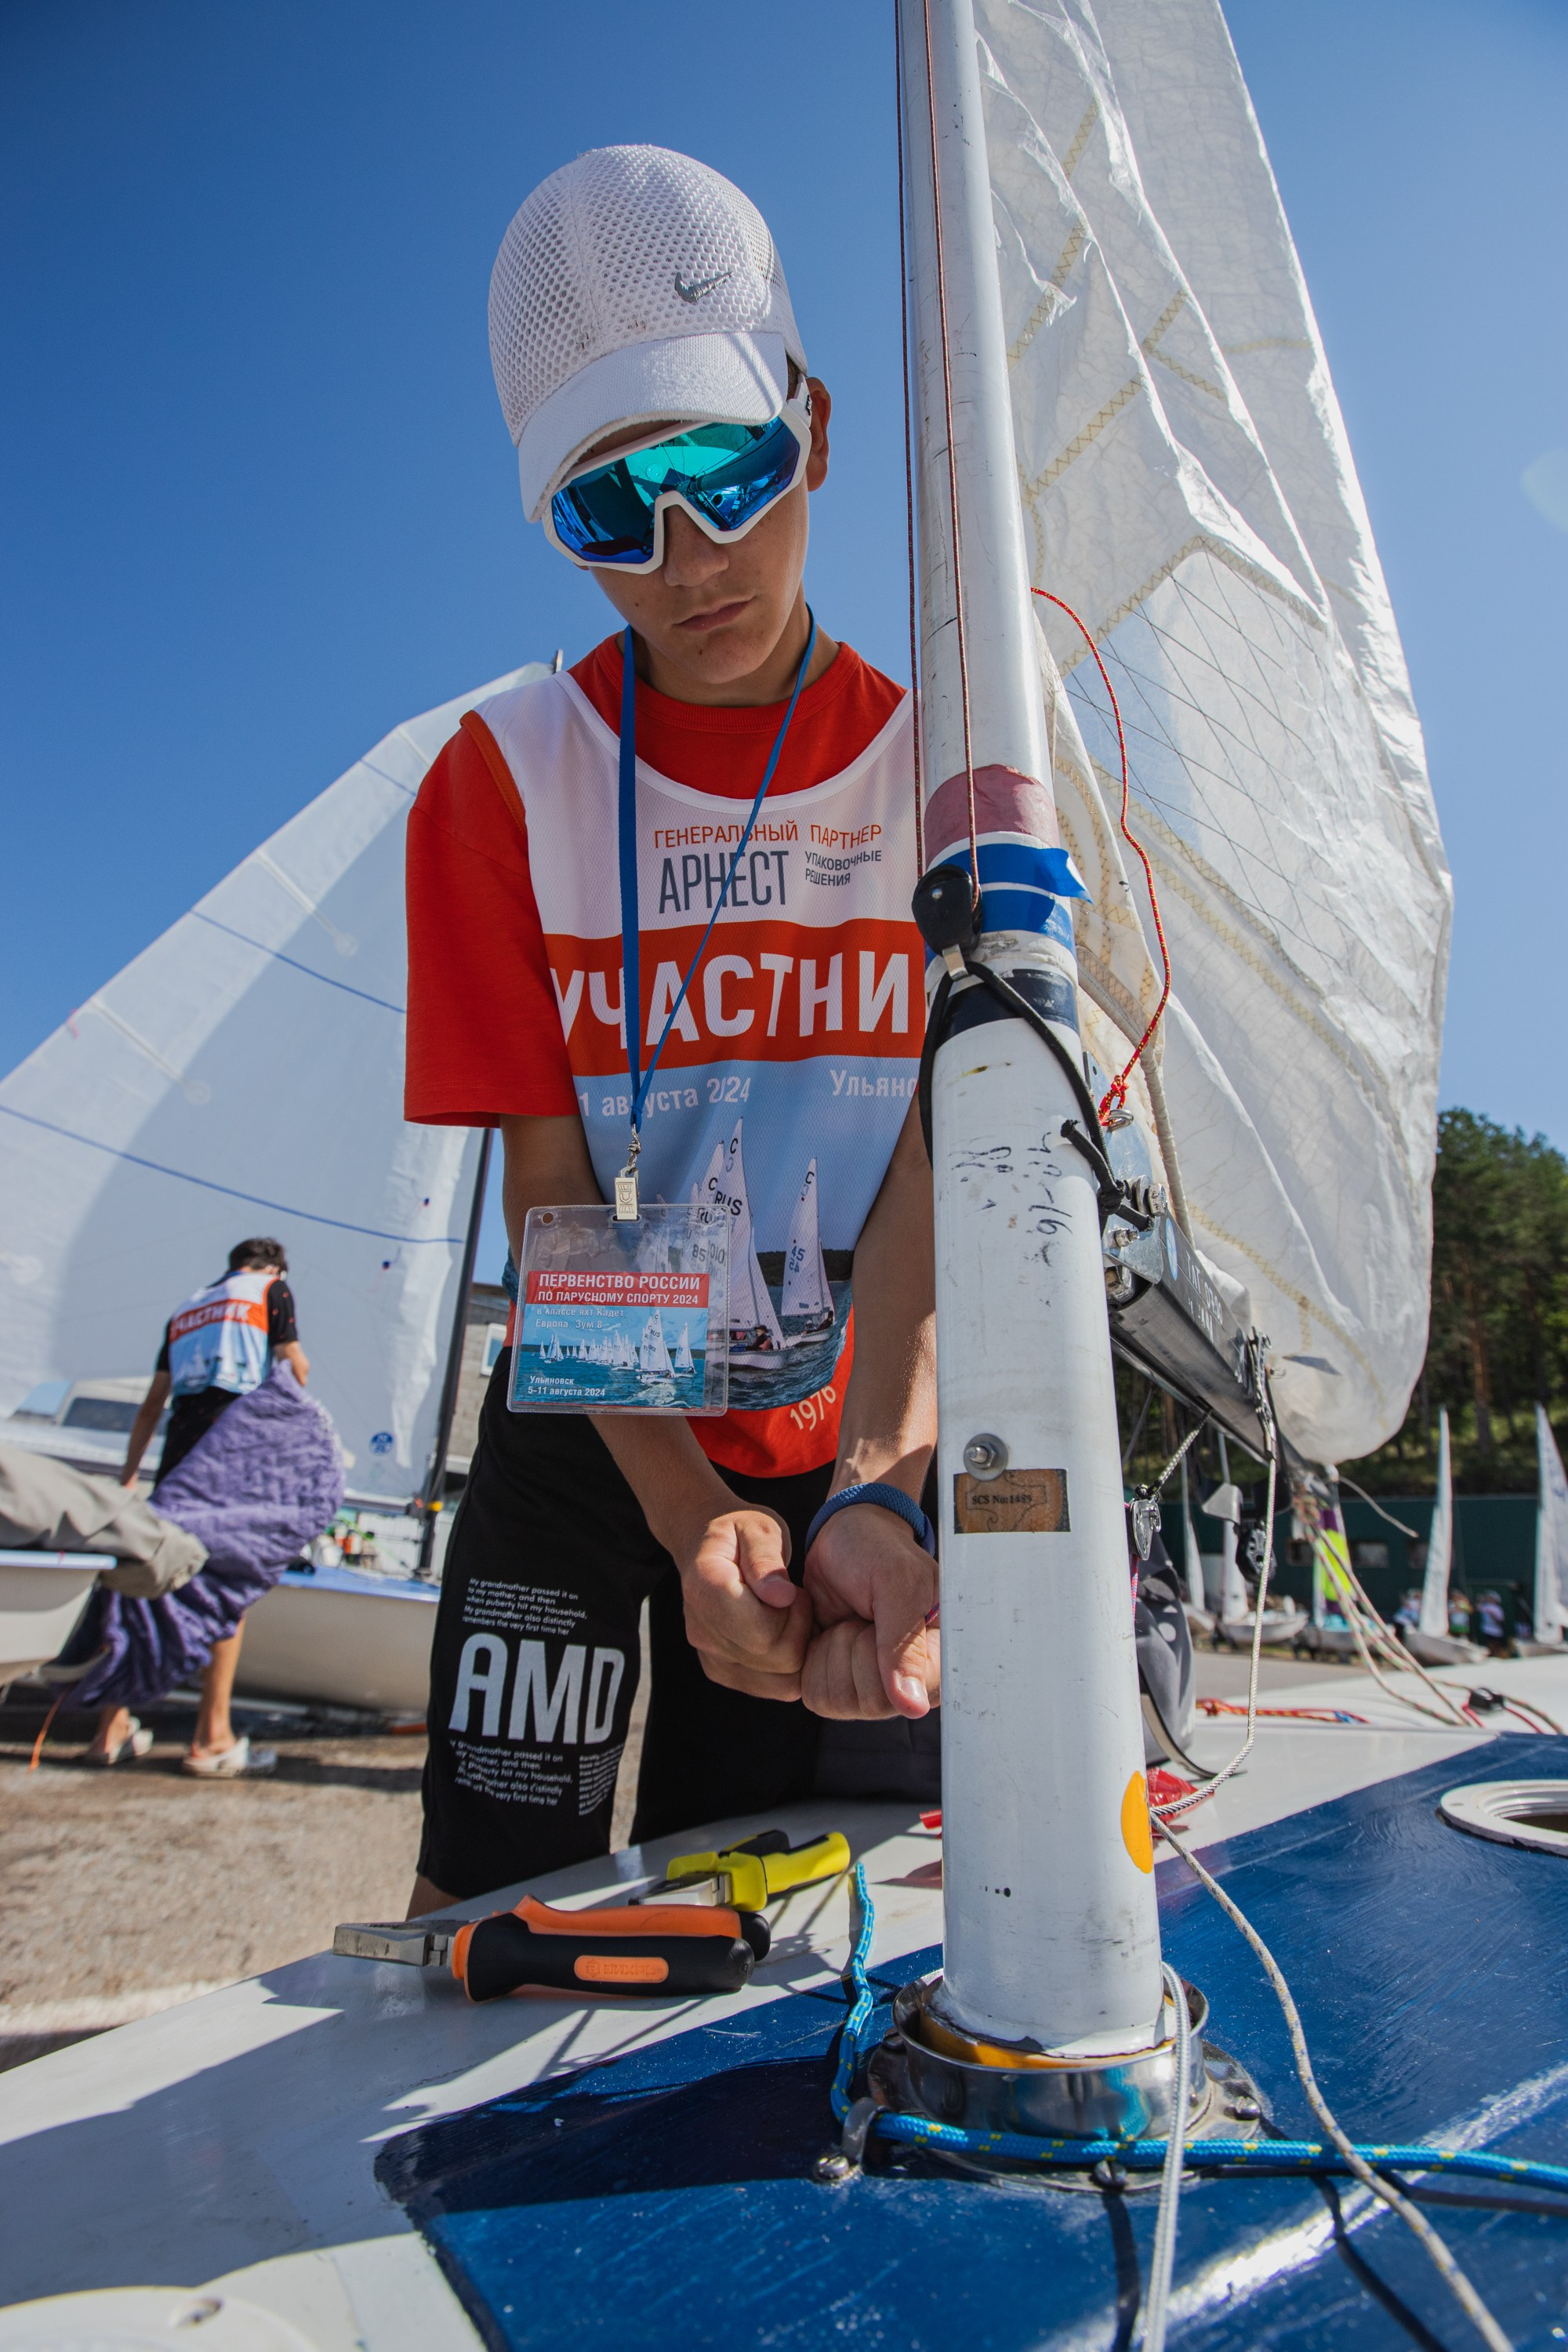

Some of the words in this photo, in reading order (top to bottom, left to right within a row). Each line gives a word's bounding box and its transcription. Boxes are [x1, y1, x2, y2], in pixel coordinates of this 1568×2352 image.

[654, 820, 798, 848] ГЕНЕРАЛЬНЫЙ
[810, 825, 882, 849] ПАРТНЕР
[805, 851, 882, 870] УПАКОВОЧНЫЕ
[659, 851, 789, 914] АРНЕСТ
[805, 868, 851, 886] РЕШЕНИЯ
[602, 1088, 699, 1118] авуста
[730, 1138, 739, 1154] C
[709, 1178, 718, 1191] C
[805, 1171, 815, 1184] C
[715, 1191, 742, 1216] RUS
[539, 1274, 634, 1289] ПЕРВЕНСТВО
[639, 1276, 700, 1290] РОССИИ
[538, 1291, 553, 1301] ПО
[556, 1291, 623, 1303] ПАРУСНОМУ
[627, 1293, 670, 1304] СПОРТУ
[673, 1294, 699, 1305] 2024
[575, 1320, 593, 1330] Зум
[597, 1320, 602, 1329] 8
[530, 1375, 575, 1385] Ульяновск
[528, 1386, 546, 1395] 5-11
[550, 1388, 582, 1397] августа
[584, 1388, 605, 1396] 2024
[790, 1385, 837, 1432] 1976
[972, 1495, 990, 1504] SCS
[475, 1588, 487, 1597] my
[488, 1590, 517, 1601] mother,
[537, 1596, 556, 1605] then
[480, 1581, 530, 1592] grandmother
[532, 1586, 560, 1597] passed
[466, 1595, 485, 1604] when
[485, 1599, 516, 1610] puberty
[530, 1605, 543, 1613] my
[545, 1605, 587, 1620] household,
[464, 1605, 474, 1615] My
[474, 1607, 522, 1620] grandmother
[524, 1613, 541, 1623] also
[543, 1616, 576, 1628] distinctly
[463, 1616, 495, 1626] remembers
[497, 1619, 508, 1628] the
[509, 1623, 524, 1632] very
[525, 1623, 539, 1632] first
[541, 1626, 557, 1635] time
[557, 1628, 569, 1636] her
[448, 1632, 625, 1745] AMD
[502, 1759, 518, 1769] and
[521, 1760, 540, 1770] then
[514, 1751, 543, 1761] passed
[545, 1752, 551, 1762] it
[553, 1754, 564, 1762] on
[501, 1767, 514, 1777] hit
[515, 1770, 528, 1780] my
[531, 1770, 574, 1784] household,
[510, 1780, 528, 1791] also
[495, 1791, 511, 1802] very
[513, 1791, 528, 1803] first
[529, 1795, 545, 1806] time
[546, 1796, 558, 1807] her
